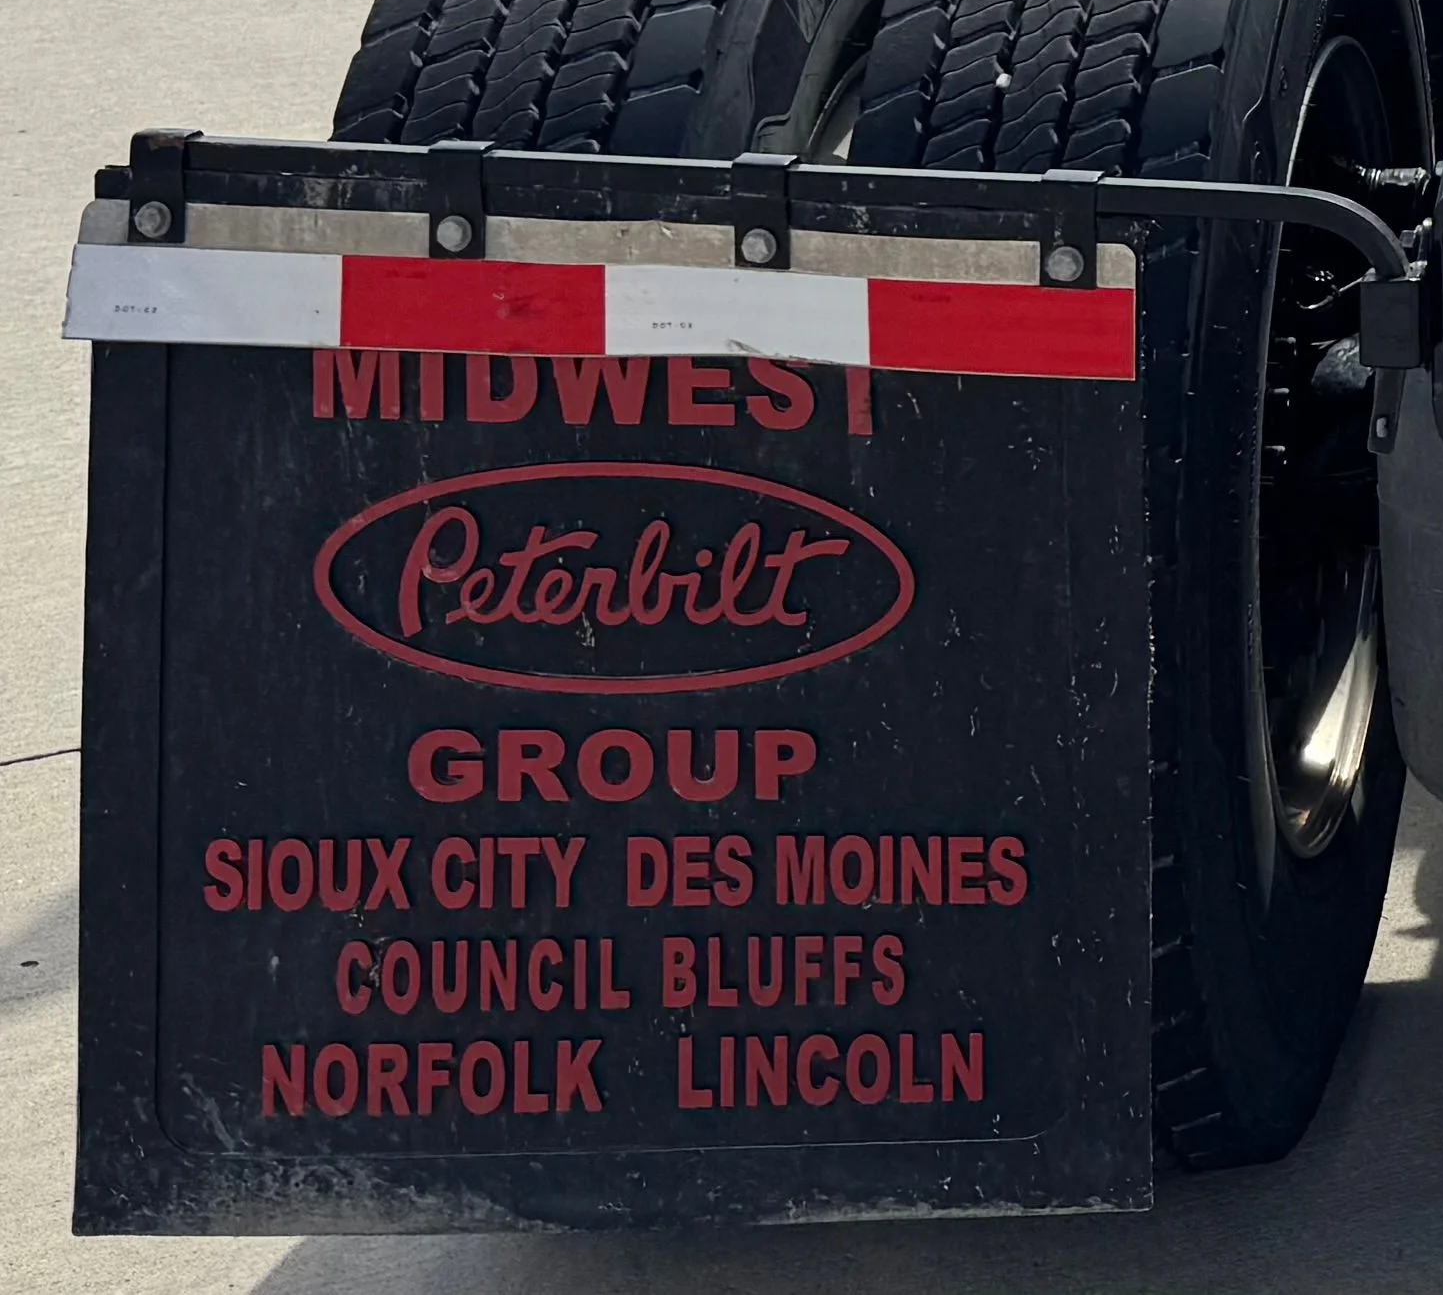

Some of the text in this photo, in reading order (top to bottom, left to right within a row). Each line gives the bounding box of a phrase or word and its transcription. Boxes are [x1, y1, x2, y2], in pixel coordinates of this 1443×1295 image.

[398, 504, 851, 638] Peterbilt
[407, 729, 818, 803] GROUP
[203, 834, 1029, 912] SIOUX CITY DES MOINES
[336, 935, 906, 1014] COUNCIL BLUFFS
[261, 1033, 984, 1117] NORFOLK LINCOLN
